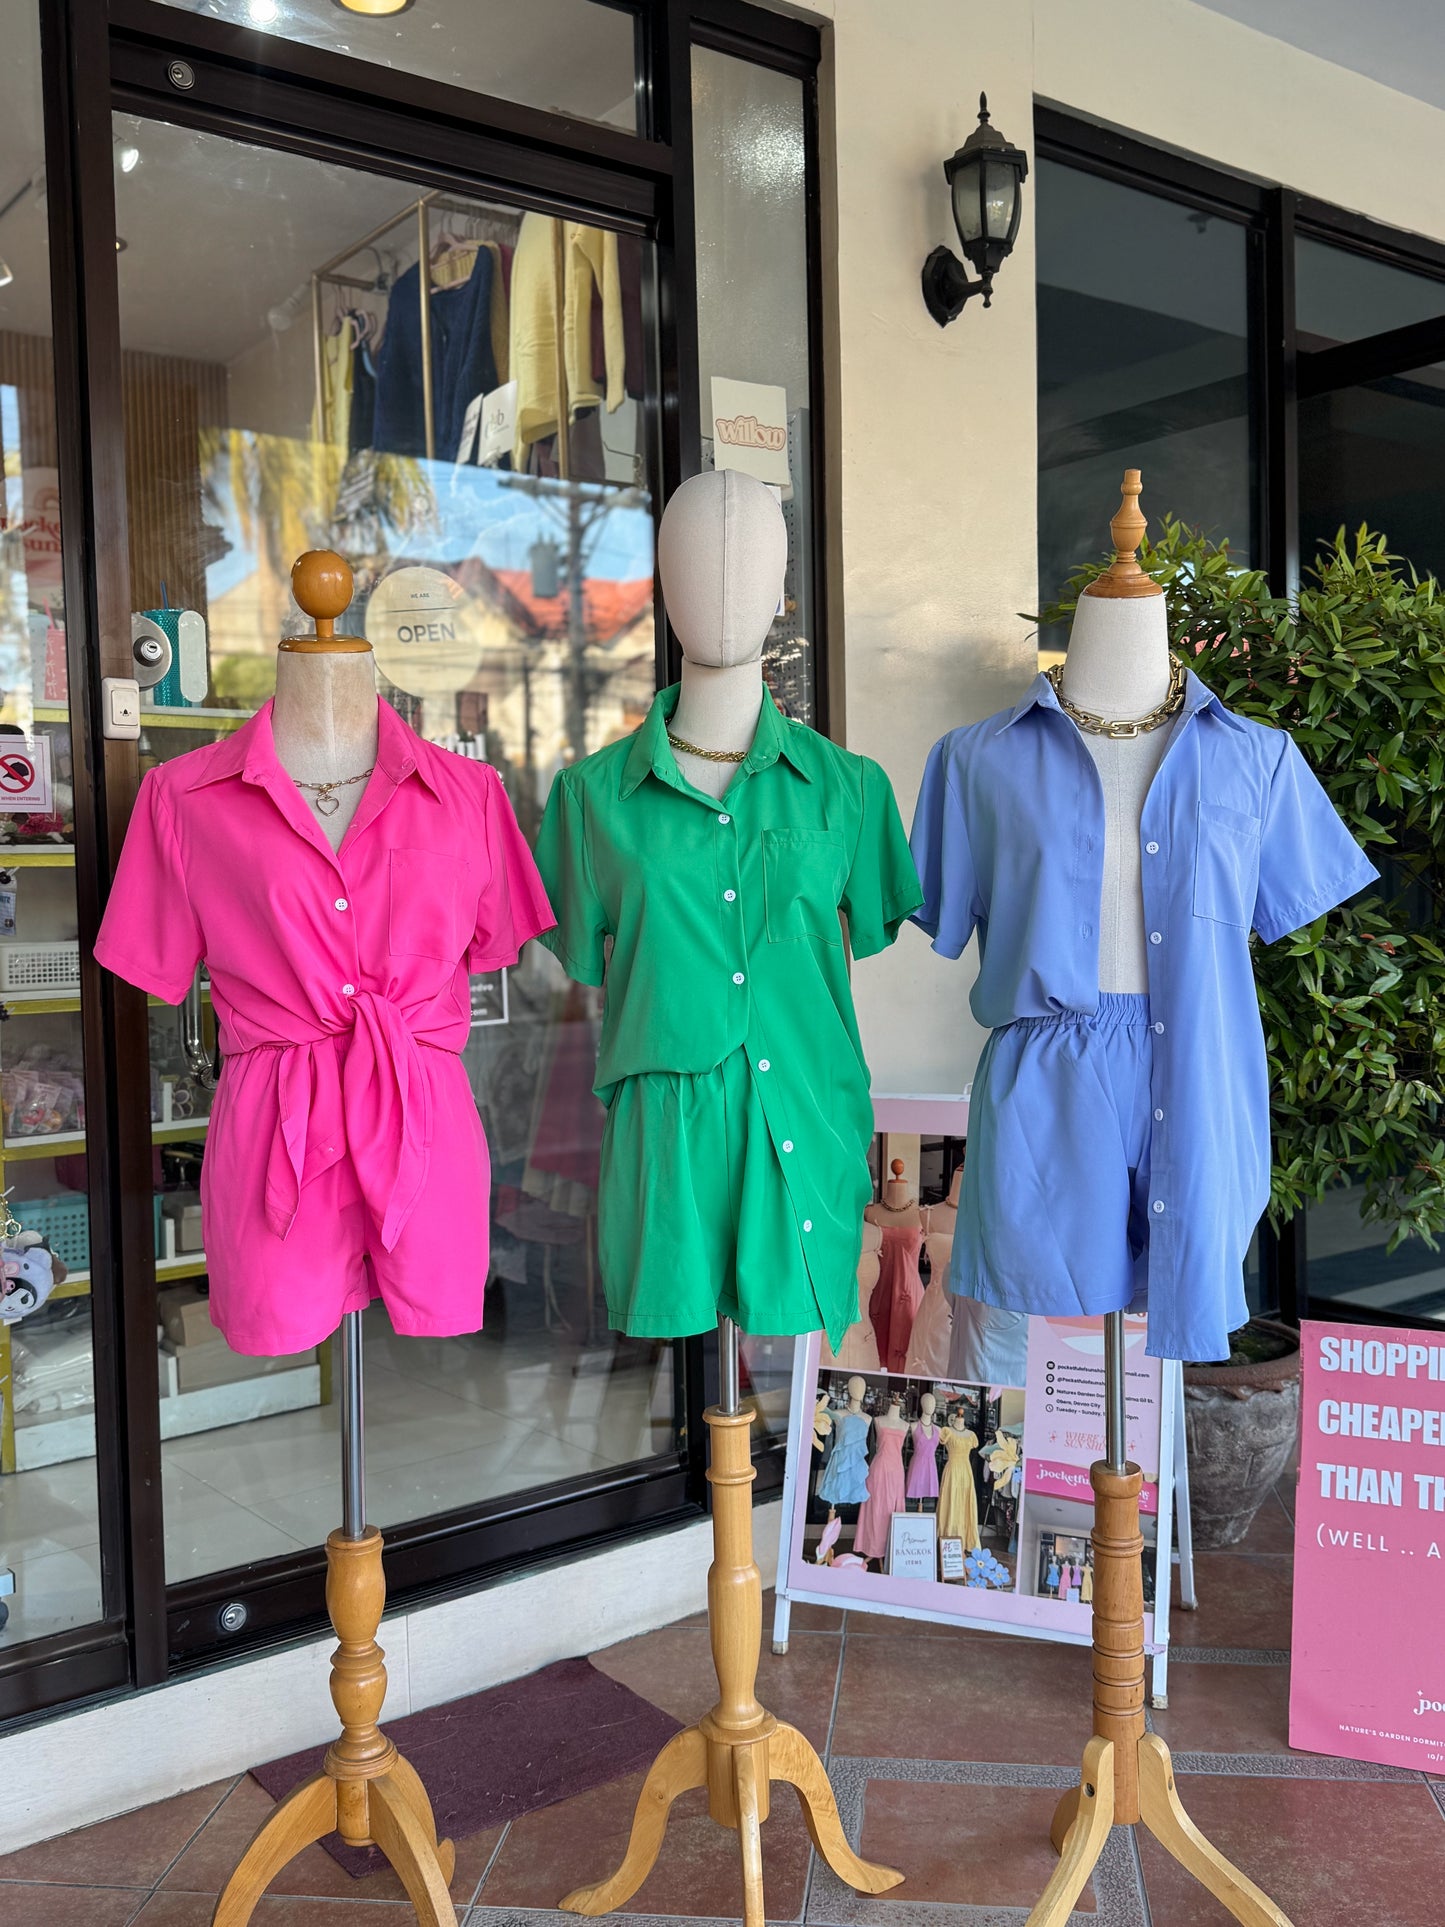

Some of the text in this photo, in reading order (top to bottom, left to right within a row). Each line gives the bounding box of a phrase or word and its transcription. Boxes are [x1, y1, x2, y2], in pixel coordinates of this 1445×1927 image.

[397, 624, 456, 643] OPEN
[1319, 1336, 1445, 1381] SHOPPI
[1318, 1399, 1445, 1446] CHEAPE
[1036, 1464, 1090, 1487] pocketfu
[1316, 1462, 1402, 1507] THAN
[895, 1548, 932, 1556] BANGKOK
[1317, 1523, 1389, 1552] (WELL
[1427, 1541, 1441, 1559] A
[1339, 1724, 1445, 1748] NATURE'S GARDEN DORMIT
